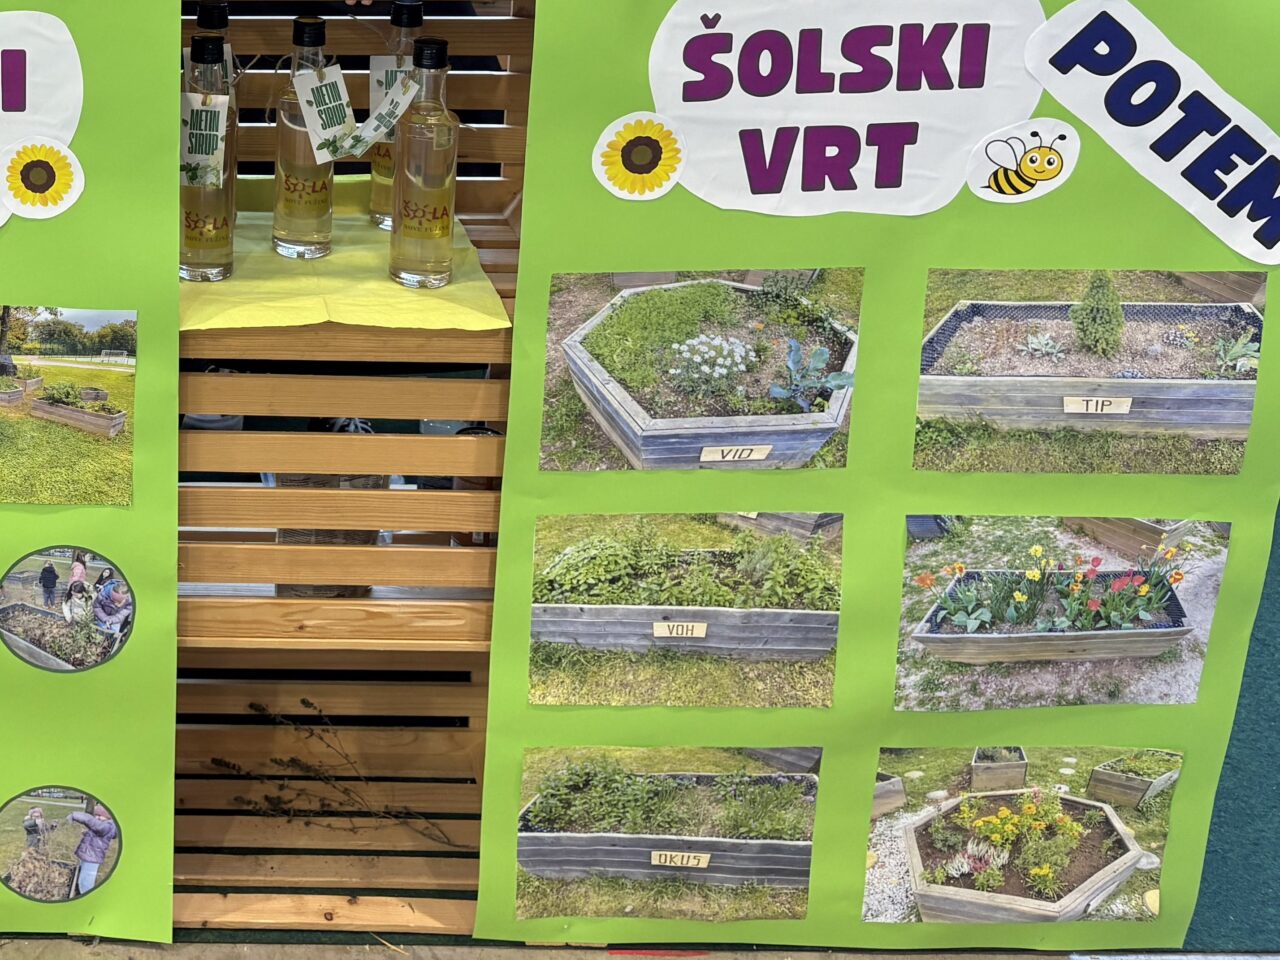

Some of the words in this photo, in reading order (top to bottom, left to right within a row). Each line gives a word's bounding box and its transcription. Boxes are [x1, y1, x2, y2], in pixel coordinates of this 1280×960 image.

[681, 13, 991, 103] ŠOLSKI
[310, 81, 343, 109] METIN
[189, 108, 221, 132] METIN
[317, 102, 348, 131] SIRUP
[187, 131, 219, 156] SIRUP
[738, 121, 920, 195] VRT
[284, 173, 329, 199] ŠOLA
[404, 200, 449, 225] ŠOLA
[1081, 399, 1113, 413] TIP
[721, 448, 754, 460] VID
[667, 624, 695, 636] VOH
[658, 853, 702, 867] OKUS
